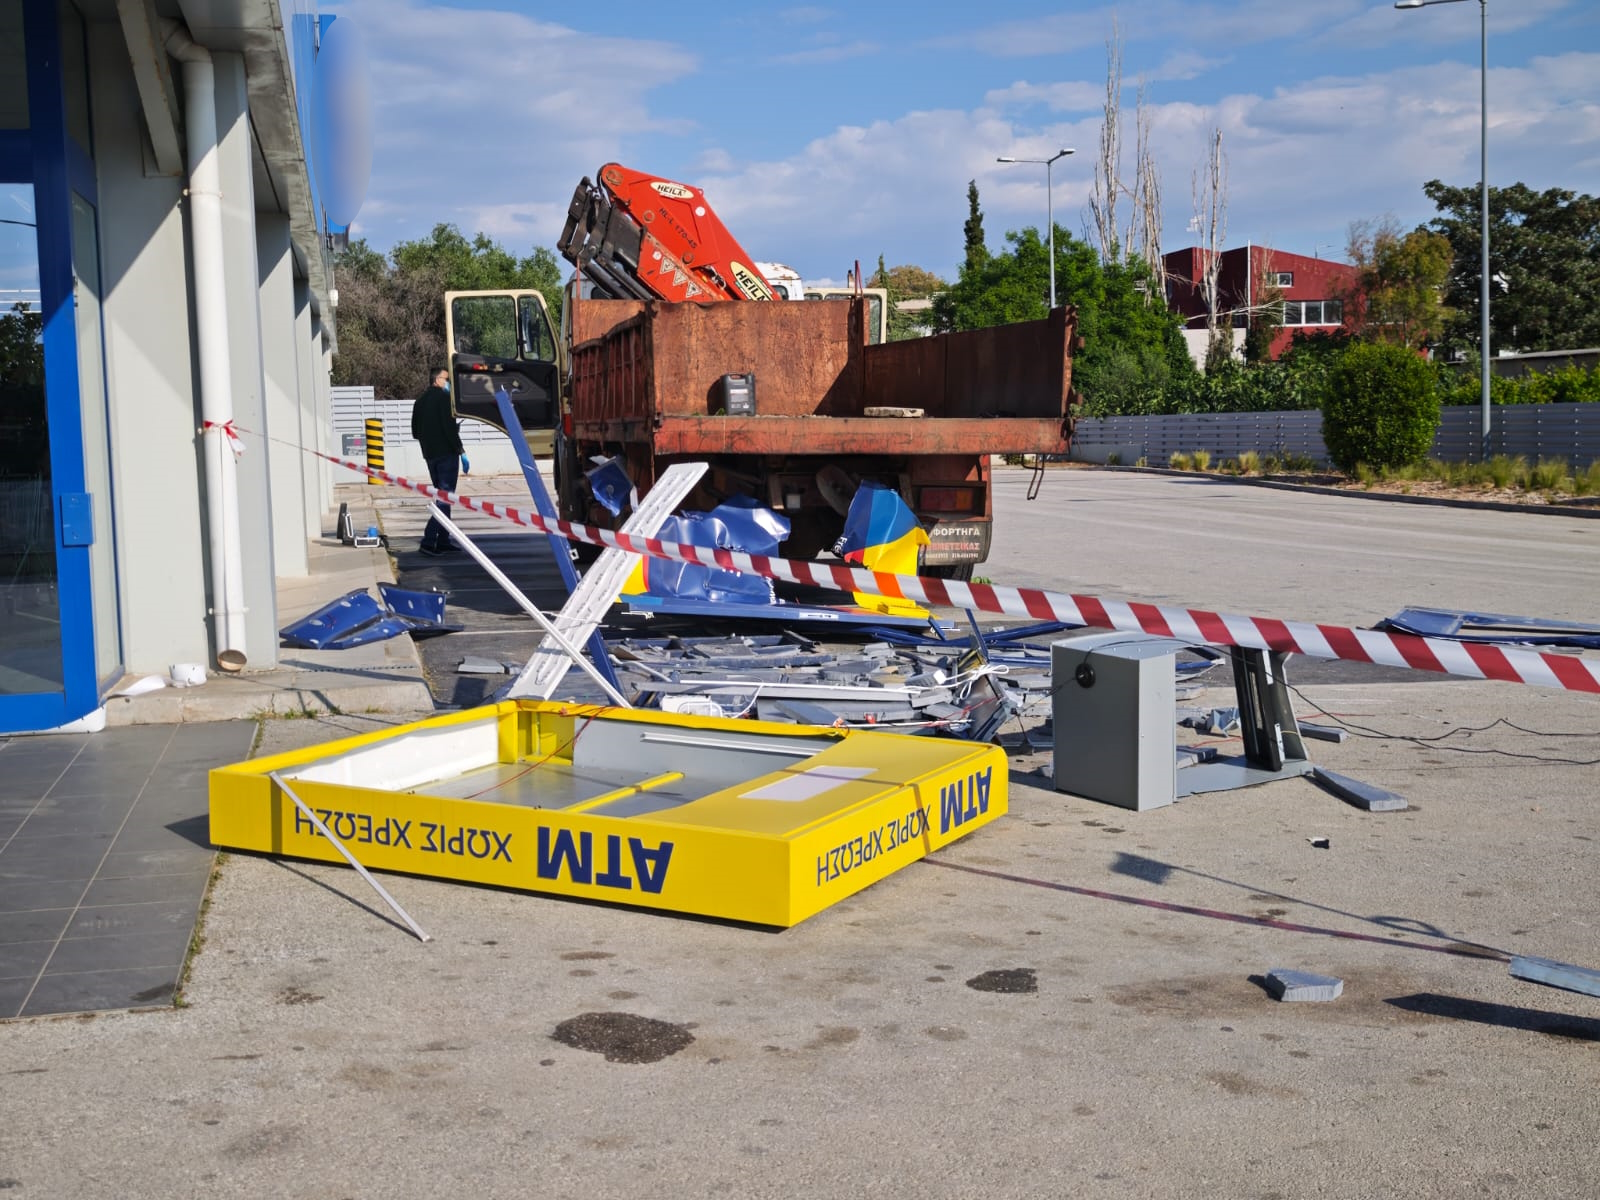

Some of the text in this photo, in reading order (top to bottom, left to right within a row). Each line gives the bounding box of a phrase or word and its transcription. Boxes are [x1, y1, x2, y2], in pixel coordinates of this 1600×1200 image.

[295, 806, 674, 894] ATM ΧΩΡΙΣ ΧΡΕΩΣΗ
[816, 766, 992, 887] ATM ΧΩΡΙΣ ΧΡΕΩΣΗ
